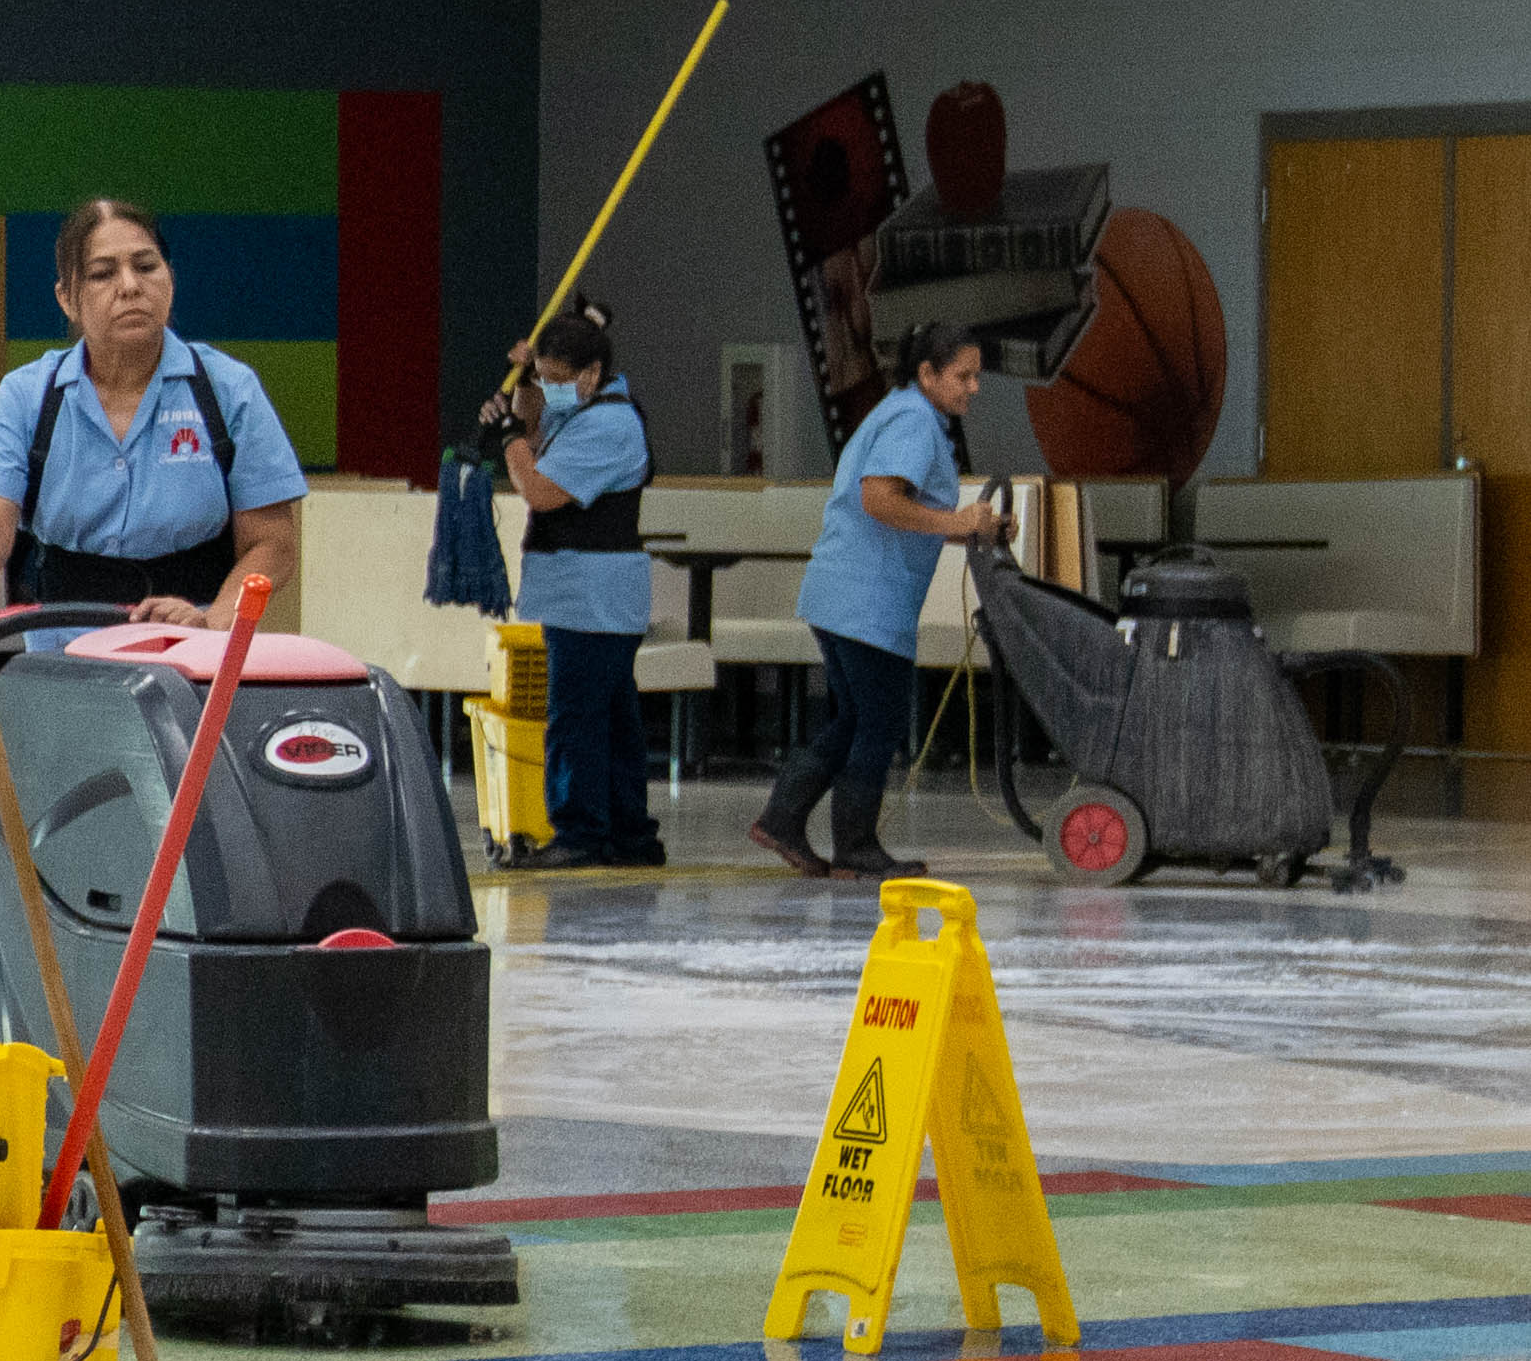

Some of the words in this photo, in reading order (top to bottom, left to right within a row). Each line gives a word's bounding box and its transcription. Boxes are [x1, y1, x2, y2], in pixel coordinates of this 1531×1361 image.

[864, 995, 920, 1031] CAUTION
[839, 1144, 873, 1171] WET
[821, 1173, 874, 1203] FLOOR
